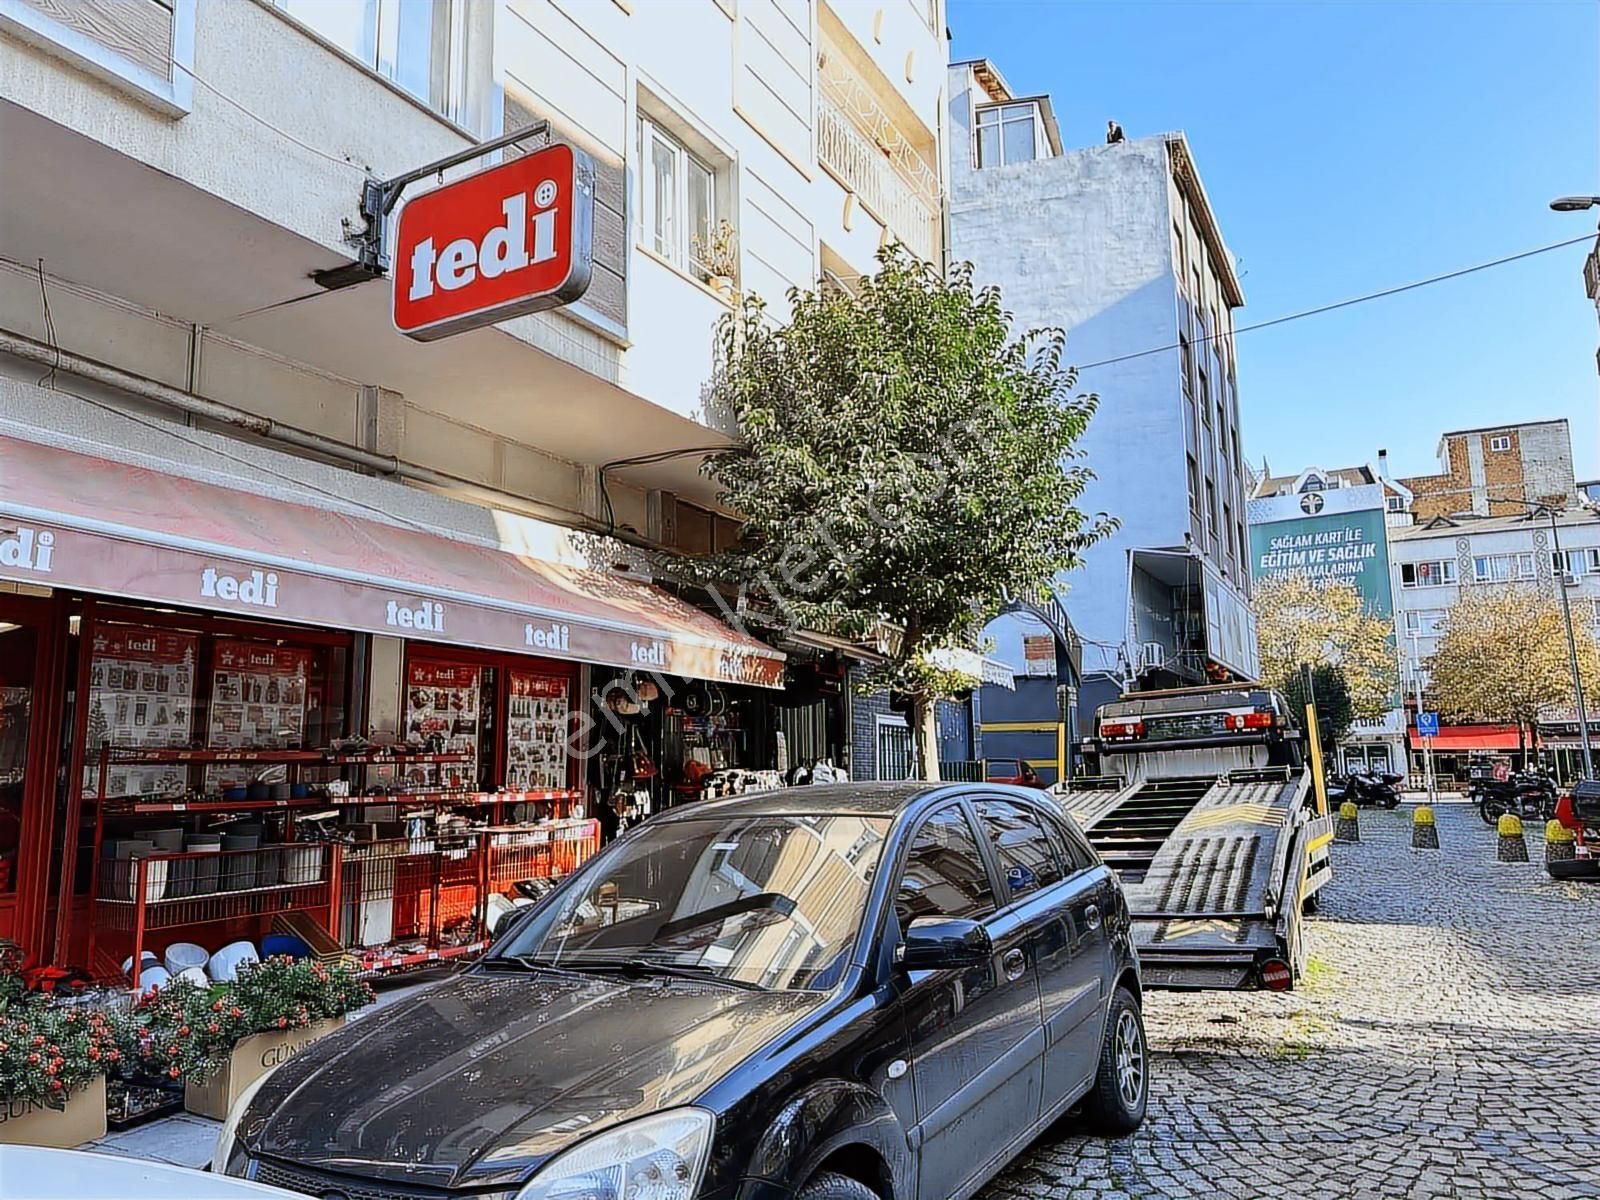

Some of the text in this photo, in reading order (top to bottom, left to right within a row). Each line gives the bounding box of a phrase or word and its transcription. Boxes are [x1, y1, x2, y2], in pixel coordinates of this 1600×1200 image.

[409, 179, 558, 302] tedi
[1270, 527, 1362, 549] SAĞLAM KART İLE
[1260, 542, 1376, 568] EĞİTİM VE SAĞLIK
[200, 567, 280, 608] tedi
[386, 600, 446, 633] tedi
[128, 638, 156, 652] tedi
[524, 623, 571, 652] tedi
[250, 653, 274, 666] tedi
[630, 641, 665, 665] tedi
[435, 668, 455, 680] tedi
